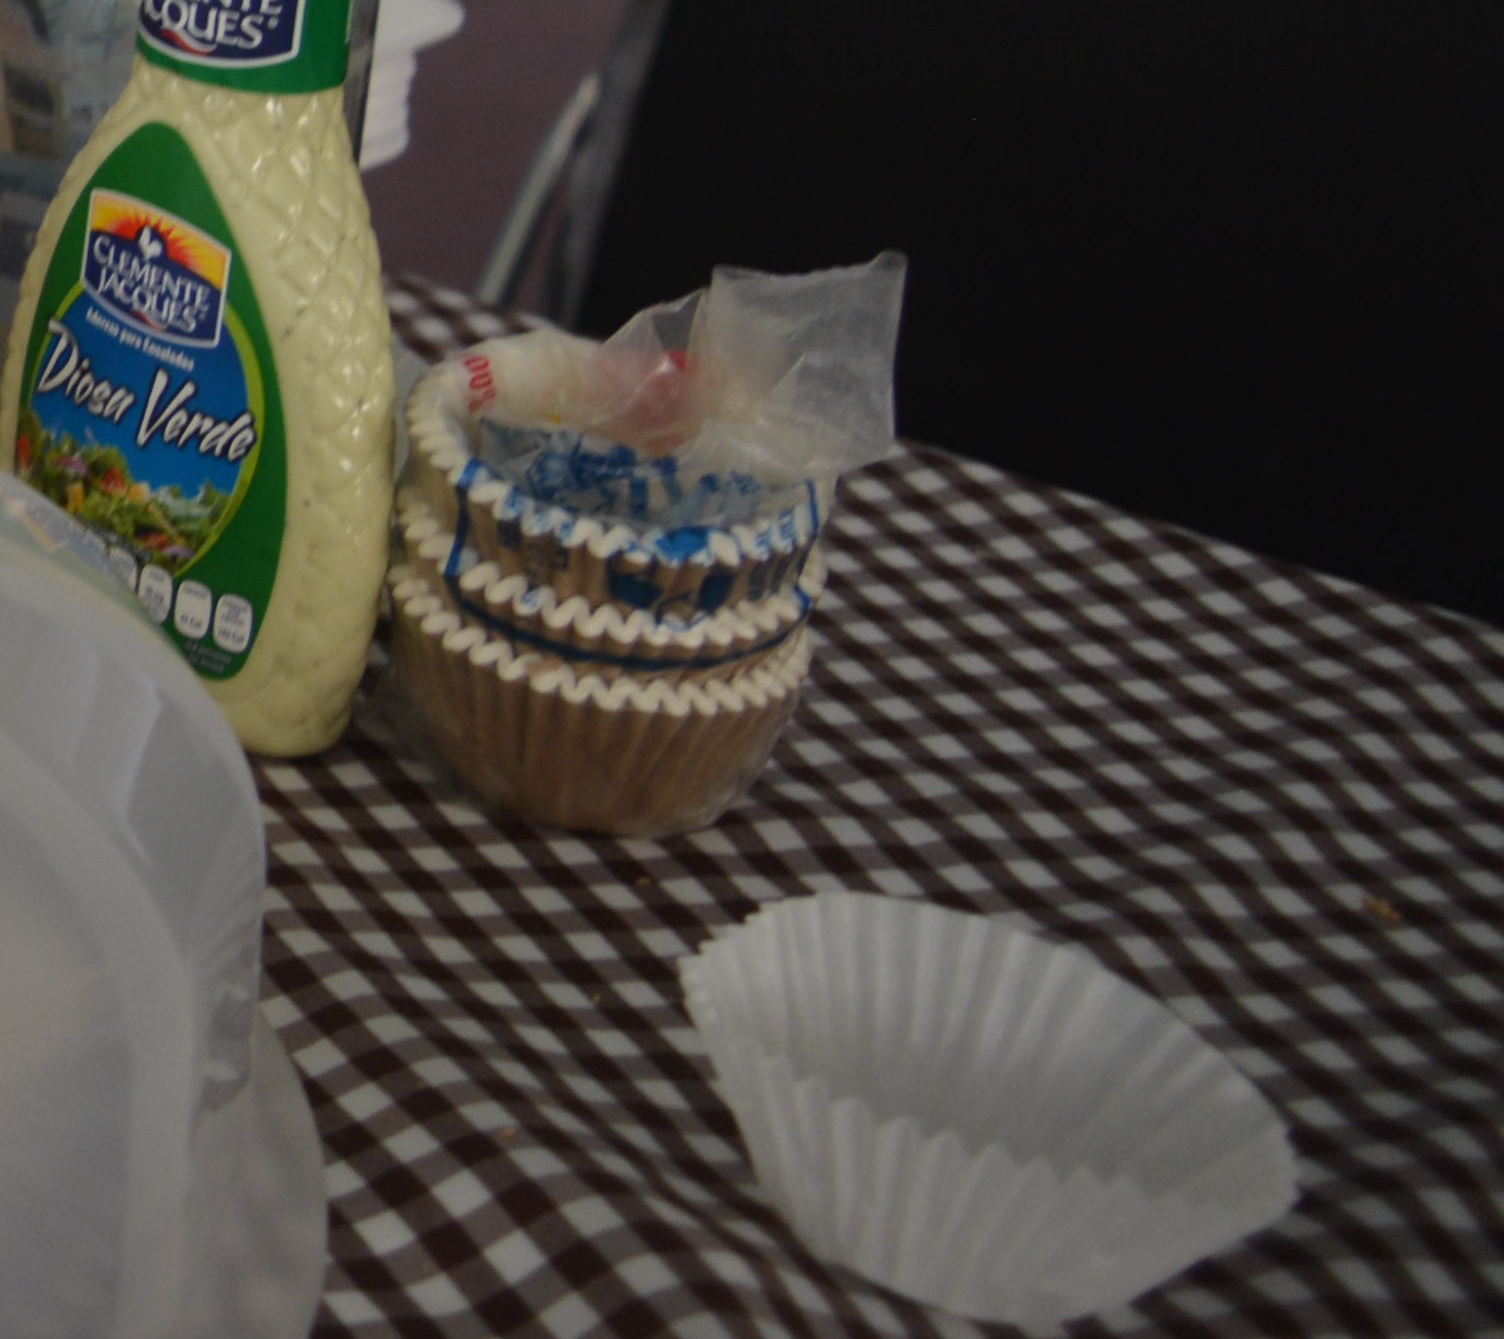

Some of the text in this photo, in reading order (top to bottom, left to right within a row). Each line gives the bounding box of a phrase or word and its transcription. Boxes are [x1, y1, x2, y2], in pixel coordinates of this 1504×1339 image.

[93, 235, 210, 310] CLEMENTE
[97, 266, 197, 334] JACQUES
[38, 318, 257, 462] Diosa Verde
